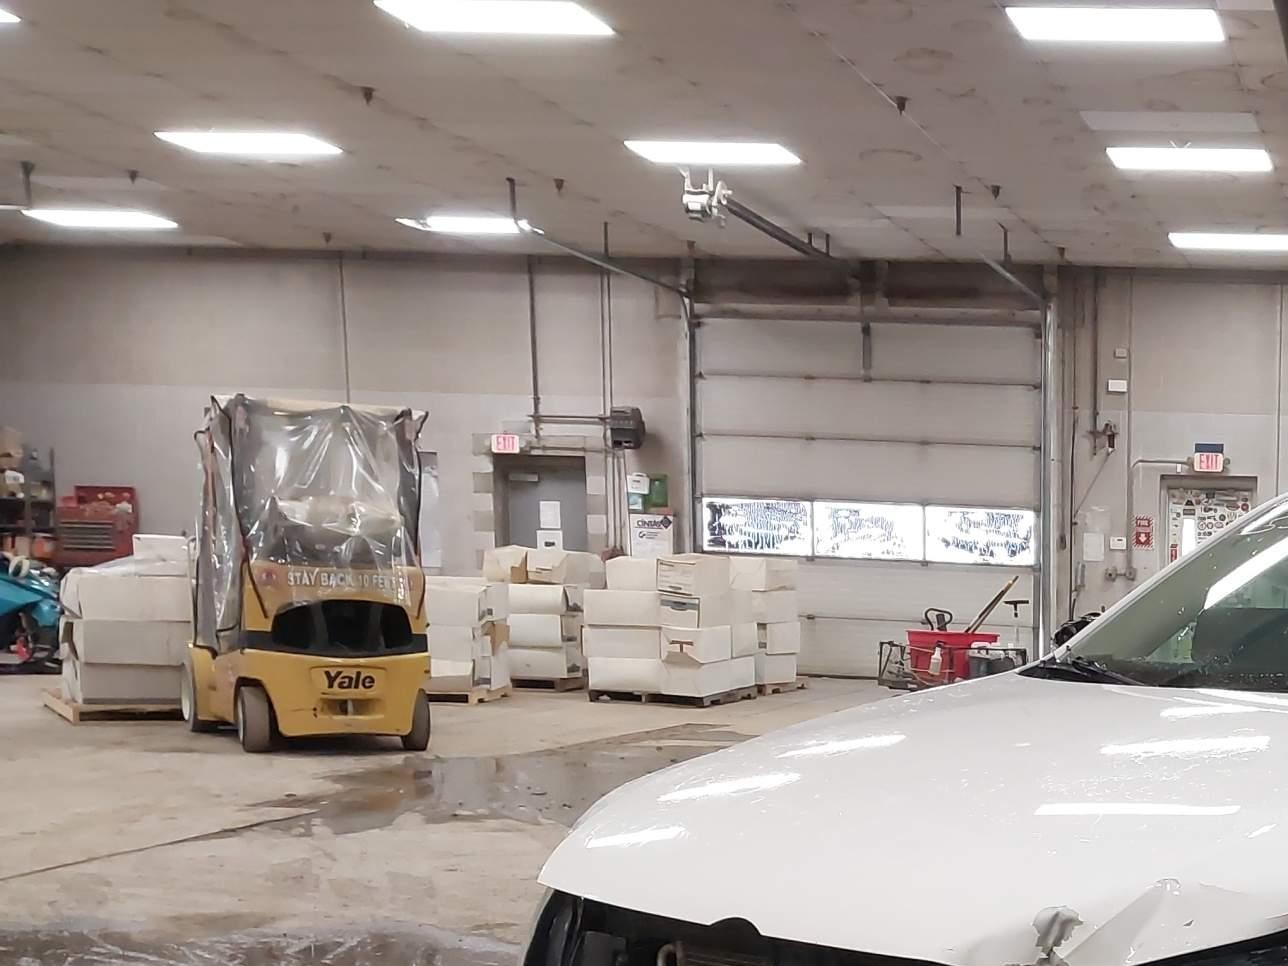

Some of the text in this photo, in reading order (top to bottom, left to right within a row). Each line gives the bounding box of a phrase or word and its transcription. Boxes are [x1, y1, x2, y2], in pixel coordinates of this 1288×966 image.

[496, 435, 515, 450] EXIT
[1199, 453, 1219, 470] EXIT
[287, 568, 319, 586] STAY
[320, 572, 354, 587] BACK
[324, 670, 376, 689] Yale
